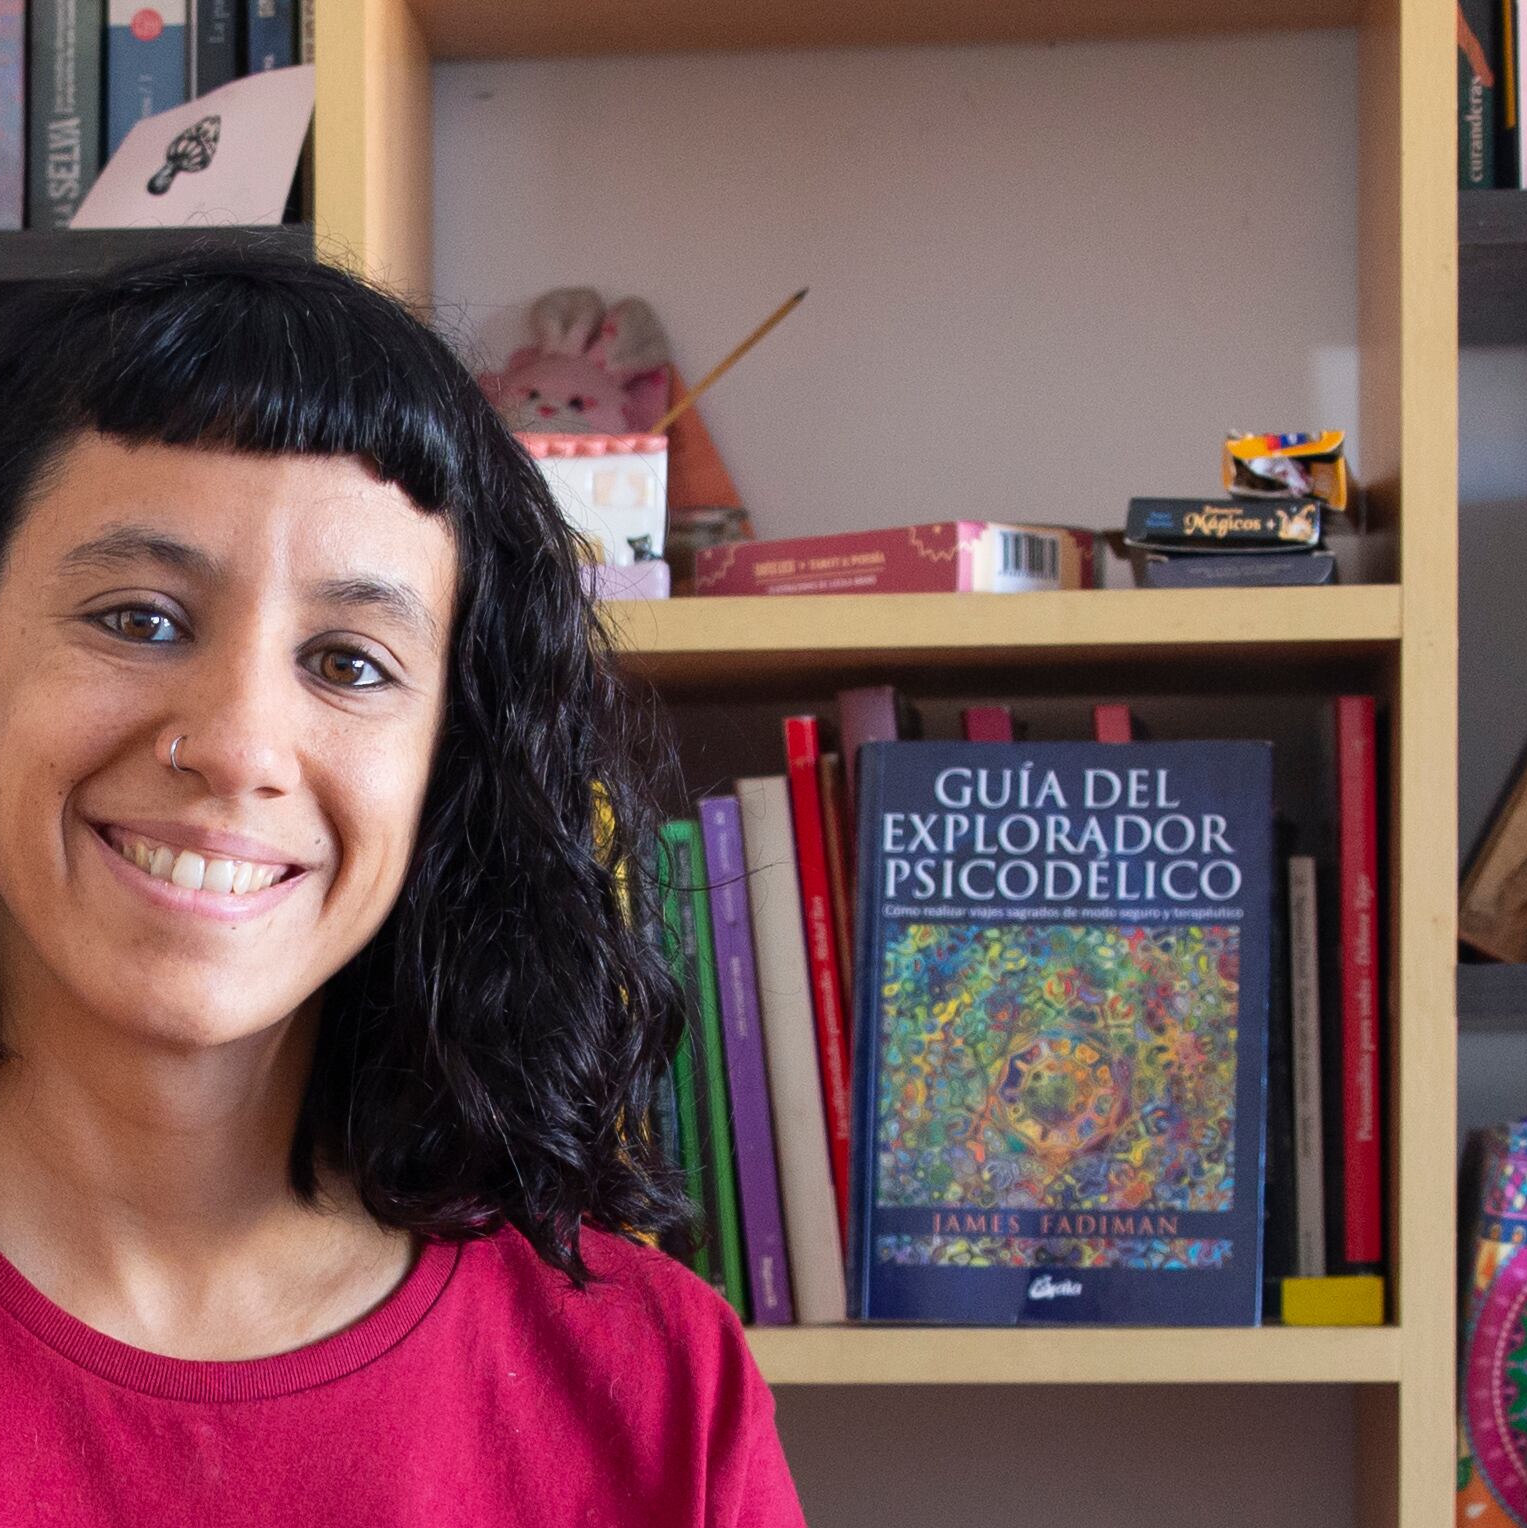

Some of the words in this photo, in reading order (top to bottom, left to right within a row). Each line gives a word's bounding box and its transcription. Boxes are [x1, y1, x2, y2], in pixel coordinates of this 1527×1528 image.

[1464, 75, 1484, 183] curanderas
[47, 117, 81, 201] SELVA
[1183, 511, 1262, 539] Mágicos
[934, 762, 1067, 811] GUÍA
[1083, 767, 1180, 810] DEL
[882, 813, 1235, 855] EXPLORADOR
[885, 851, 1243, 900] PSICODÉLICO
[924, 905, 966, 918] realizar
[970, 905, 1004, 921] viajes
[1007, 905, 1059, 921] sagrados
[1063, 905, 1076, 918] de
[1082, 905, 1116, 918] modo
[1120, 906, 1160, 922] seguro
[933, 1212, 1020, 1236] JAMES
[1039, 1211, 1178, 1236] FADIMAN
